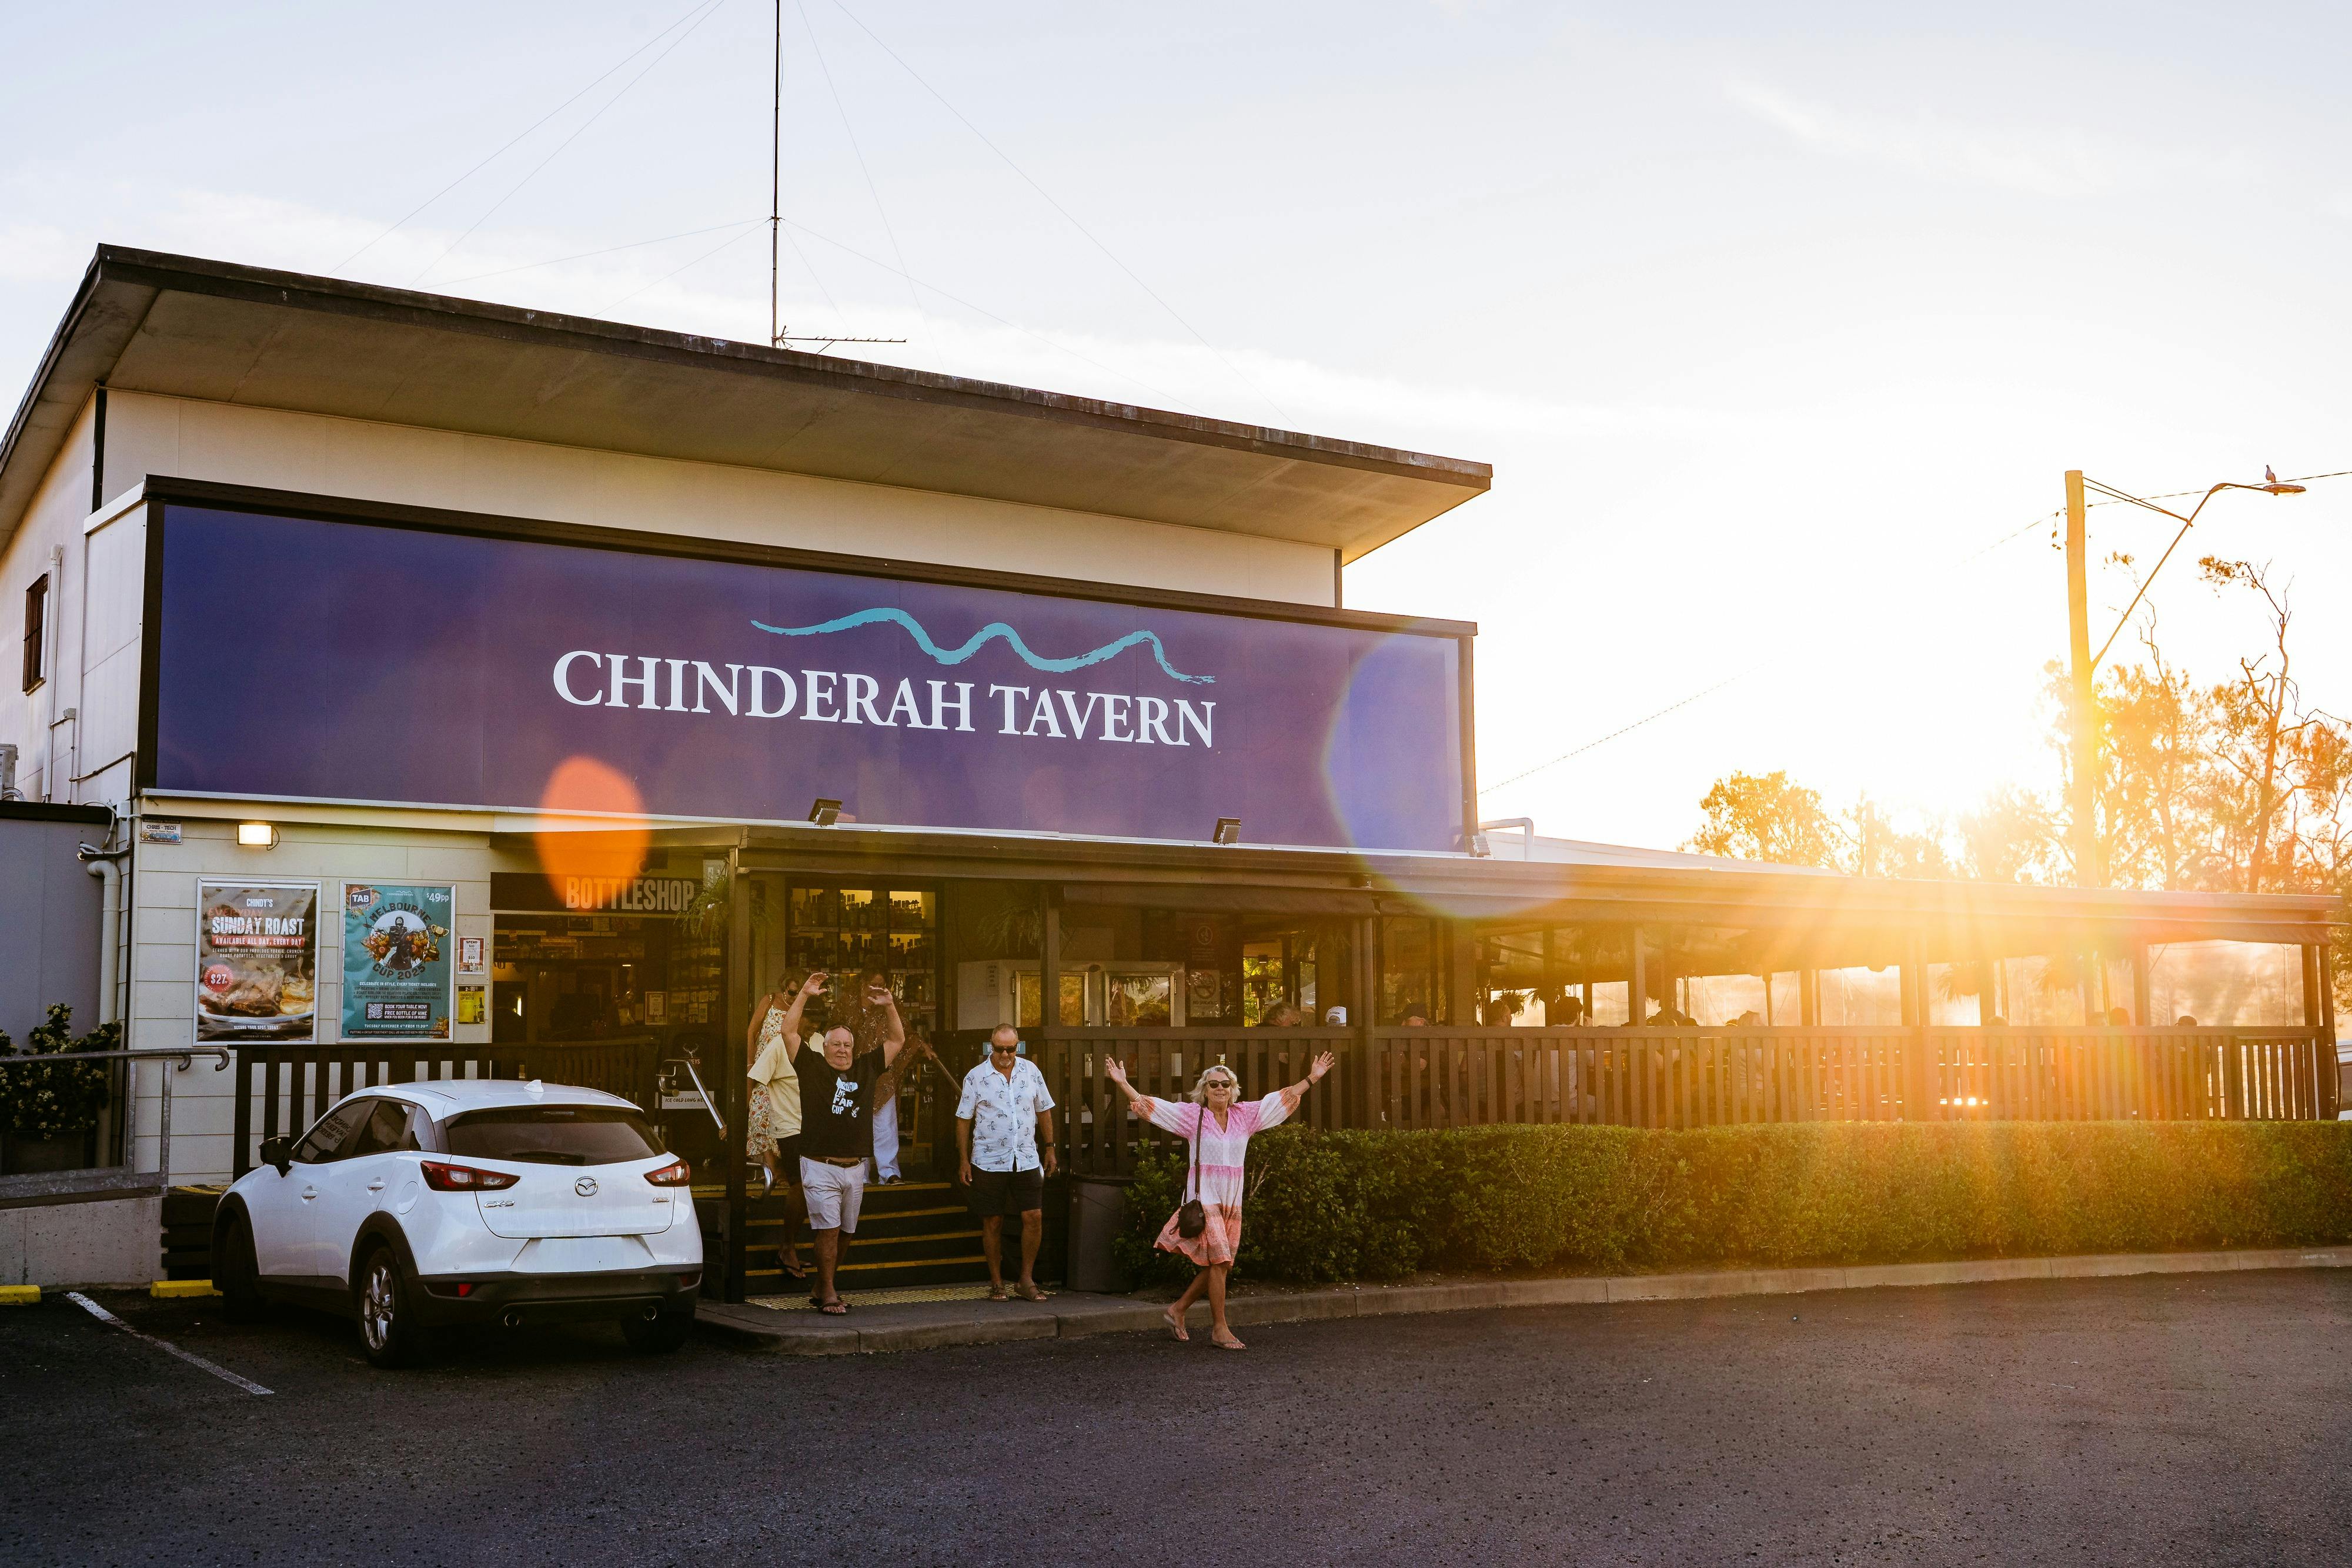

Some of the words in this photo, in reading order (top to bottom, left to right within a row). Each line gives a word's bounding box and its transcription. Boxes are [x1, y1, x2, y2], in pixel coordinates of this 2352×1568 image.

[553, 650, 975, 732] CHINDERAH
[988, 683, 1217, 749] TAVERN
[246, 898, 273, 907] CHINDY'S
[353, 894, 369, 902] TAB
[566, 877, 694, 911] BOTTLESHOP
[369, 902, 432, 924] MELBOURNE
[212, 916, 262, 935] SUNDAY
[265, 918, 305, 935] ROAST
[372, 962, 394, 978] CUP
[397, 964, 426, 980] 2025
[831, 1104, 844, 1115] CUP
[833, 1094, 853, 1107] FAR
